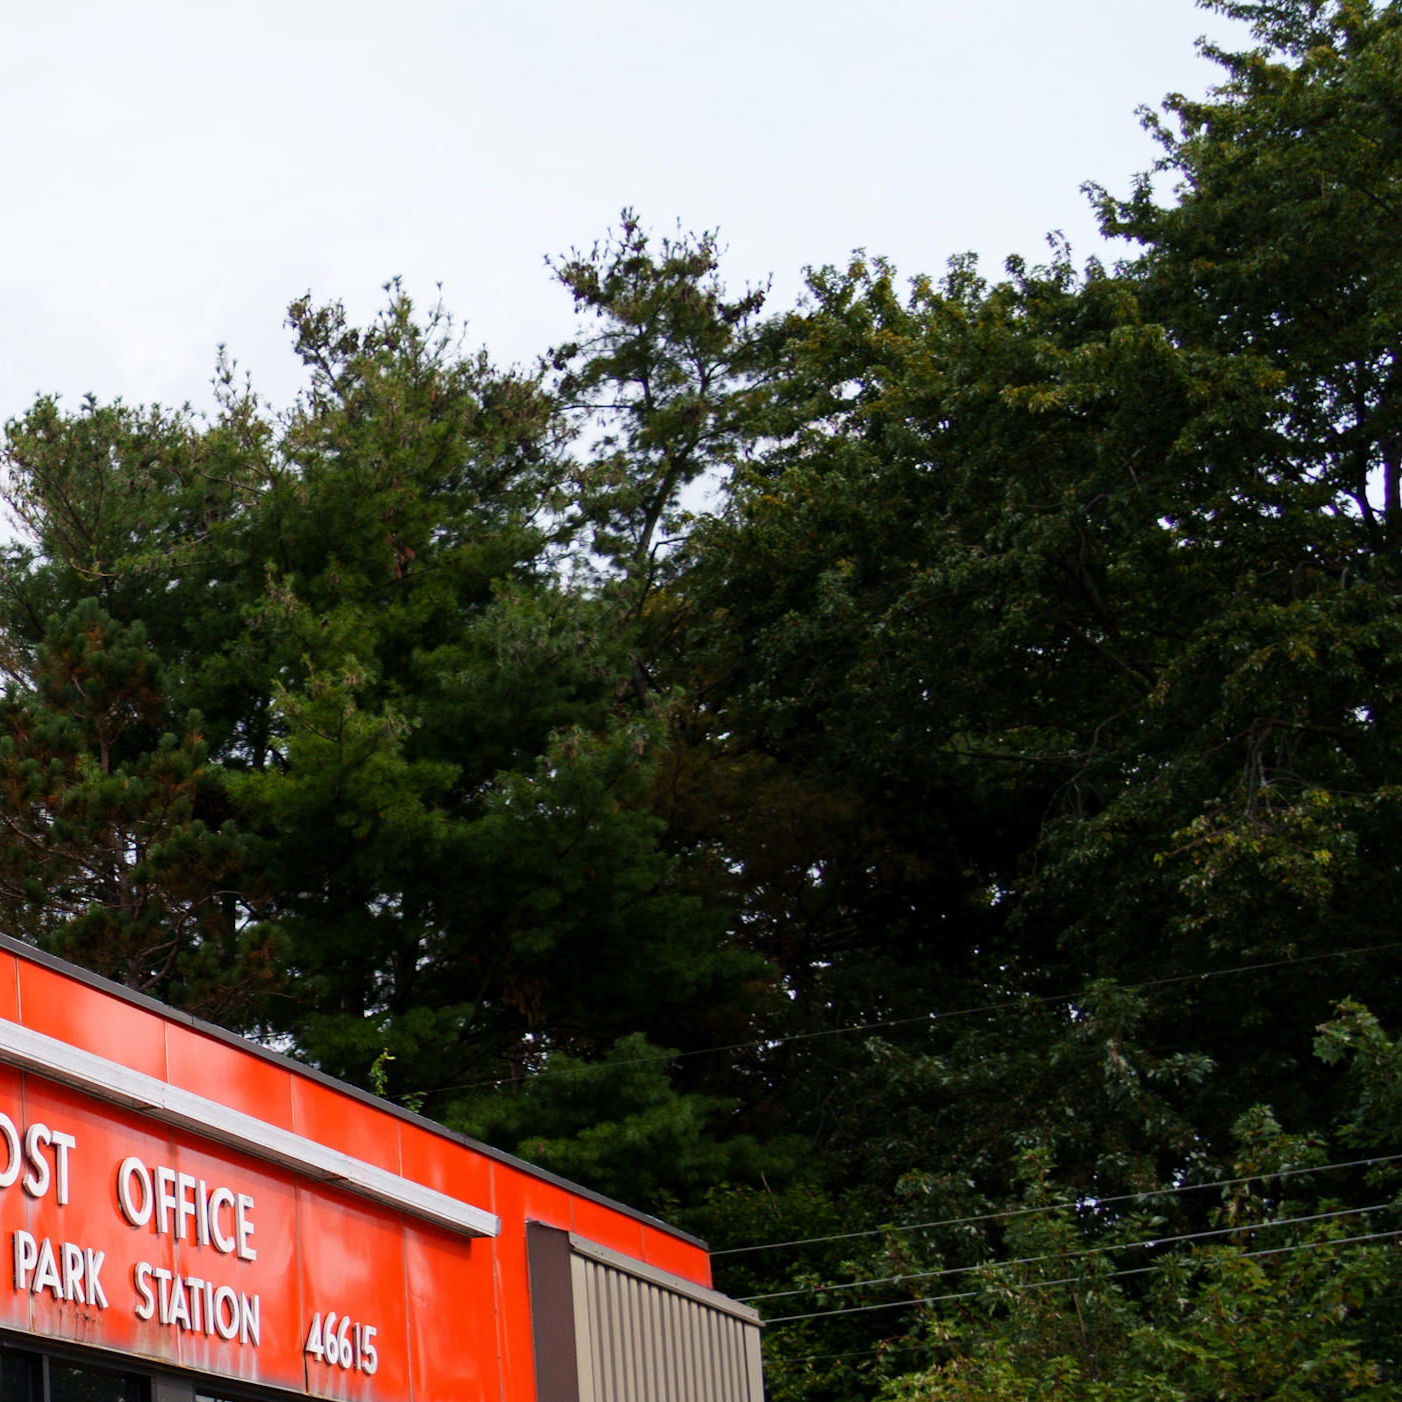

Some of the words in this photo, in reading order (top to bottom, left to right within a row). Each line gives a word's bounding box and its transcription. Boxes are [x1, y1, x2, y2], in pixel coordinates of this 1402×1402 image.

[118, 1156, 258, 1262] OFFICE
[13, 1229, 109, 1309] PARK
[134, 1261, 261, 1347] STATION
[305, 1311, 378, 1376] 46615
